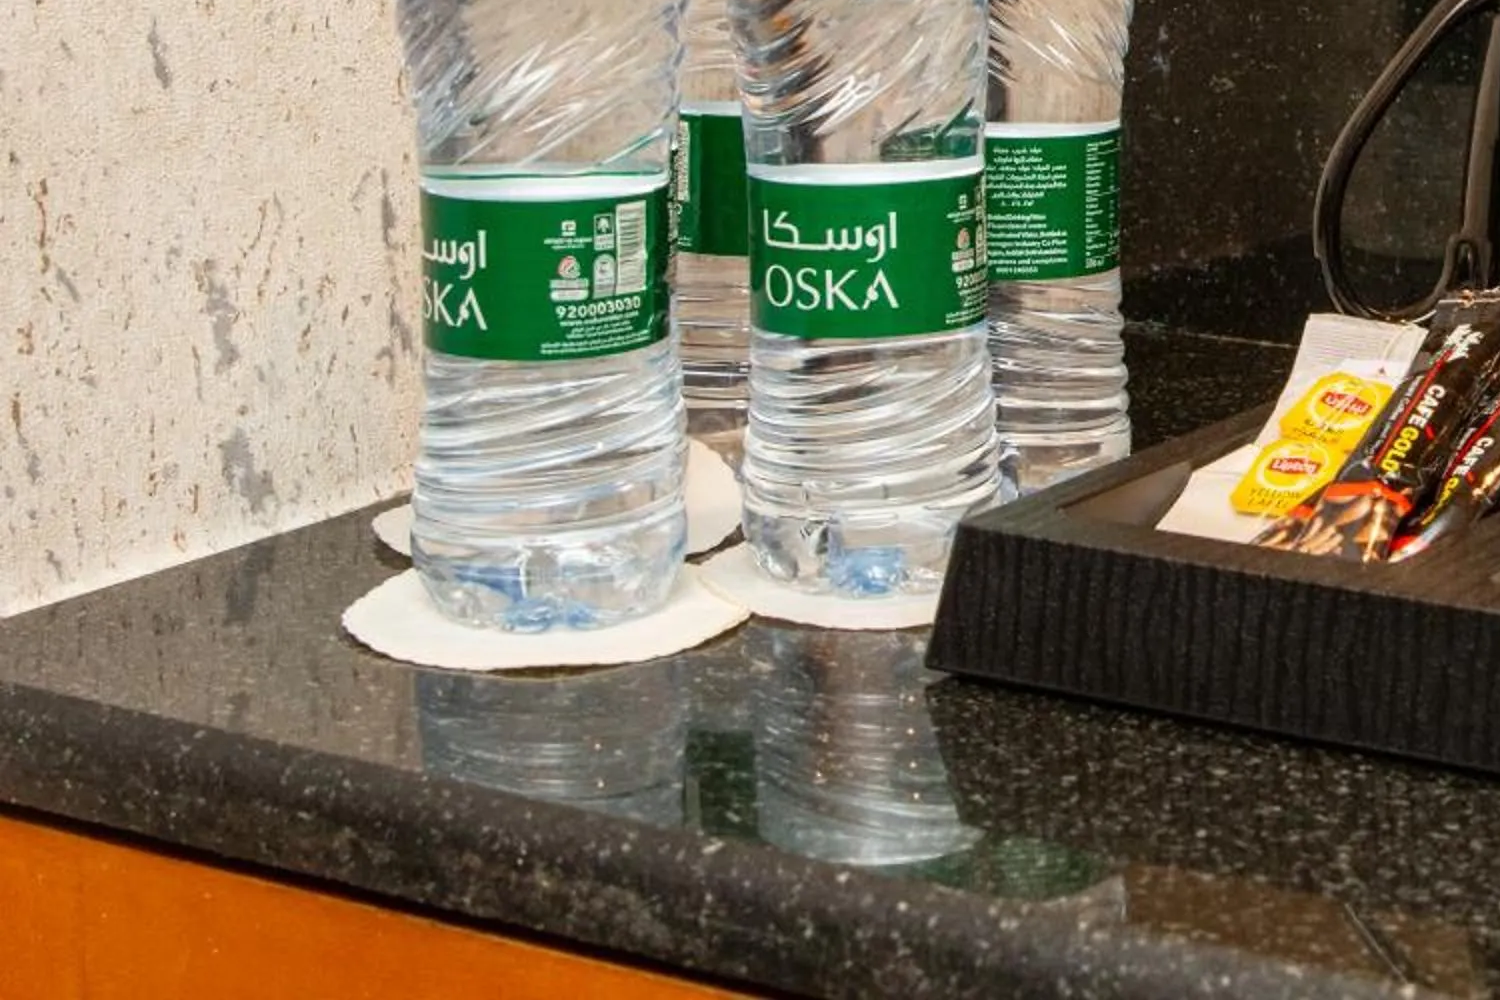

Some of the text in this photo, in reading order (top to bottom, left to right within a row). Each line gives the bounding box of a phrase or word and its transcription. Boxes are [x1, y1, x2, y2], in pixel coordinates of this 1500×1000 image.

[763, 208, 897, 264] اوسكا
[555, 295, 641, 319] 920003030
[765, 264, 900, 311] OSKA
[1381, 427, 1420, 473] GOLD
